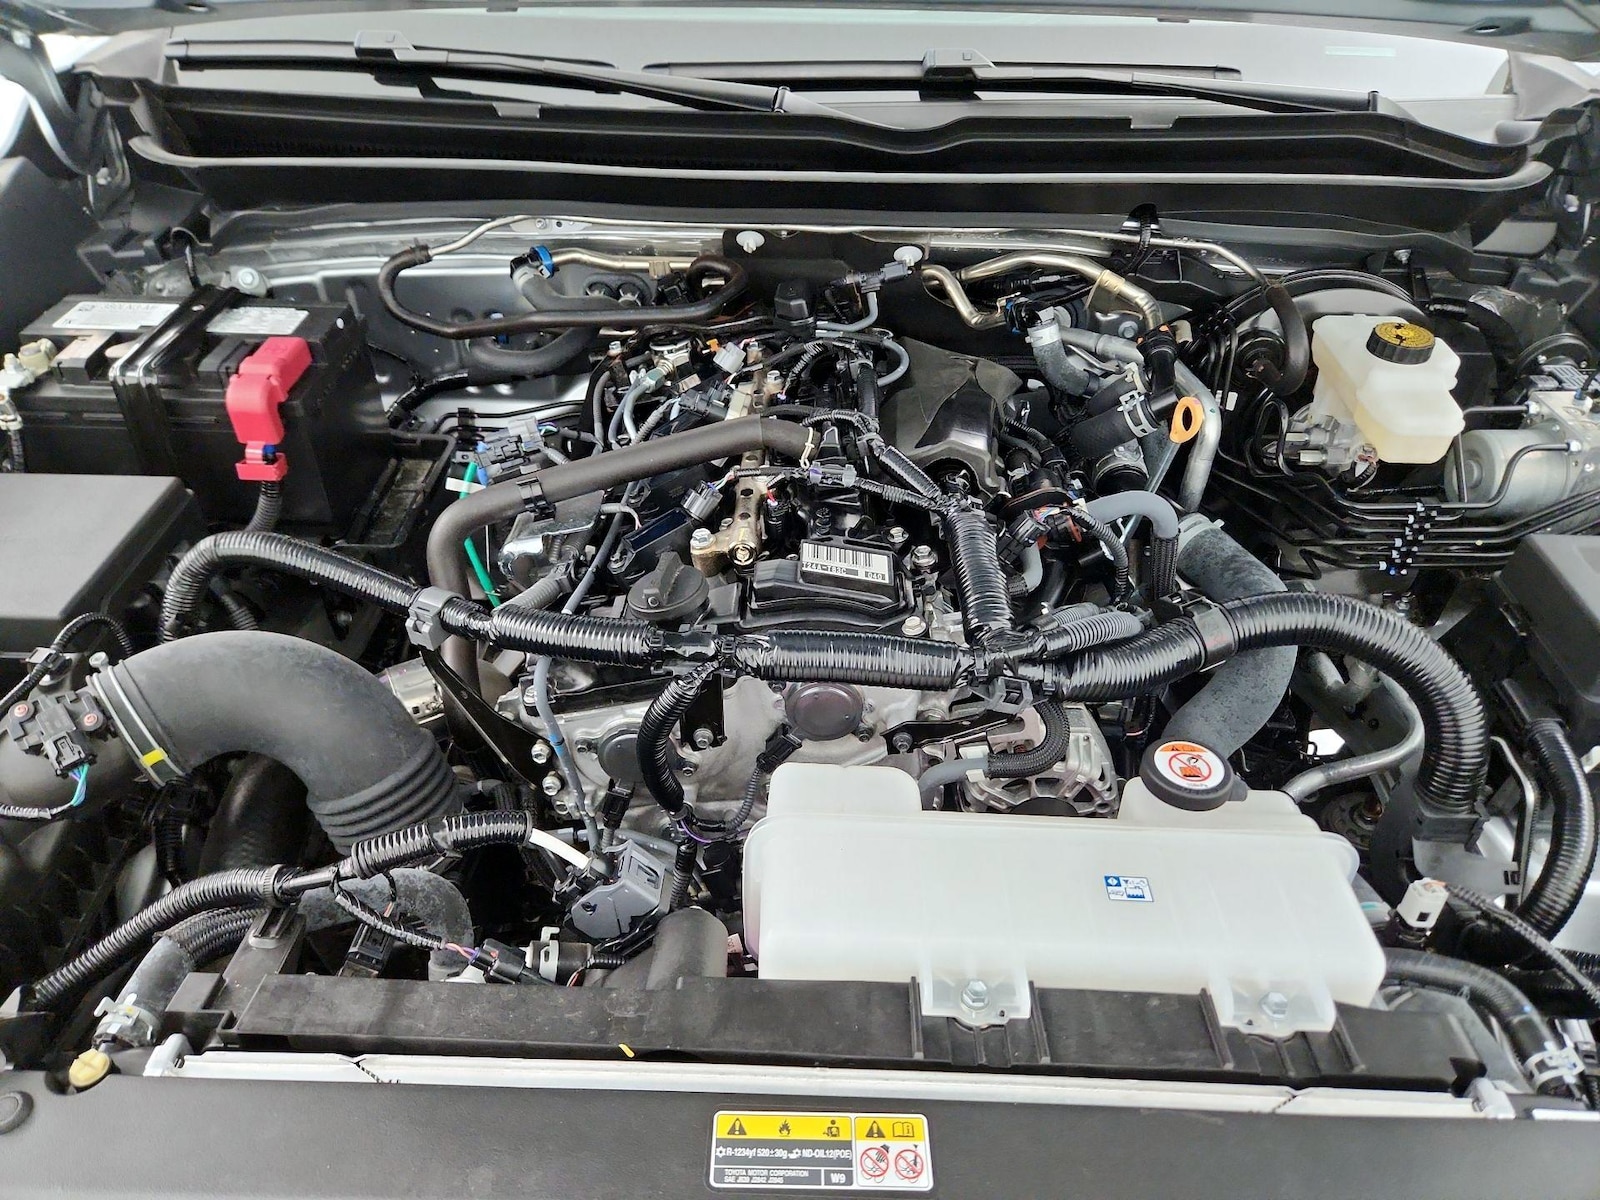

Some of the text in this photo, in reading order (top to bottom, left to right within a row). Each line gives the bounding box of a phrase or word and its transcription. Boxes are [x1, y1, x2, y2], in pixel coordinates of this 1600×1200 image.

[726, 1147, 756, 1158] R-1234yf
[802, 1149, 852, 1160] ND-OIL12(POE)
[830, 1173, 846, 1184] W9
